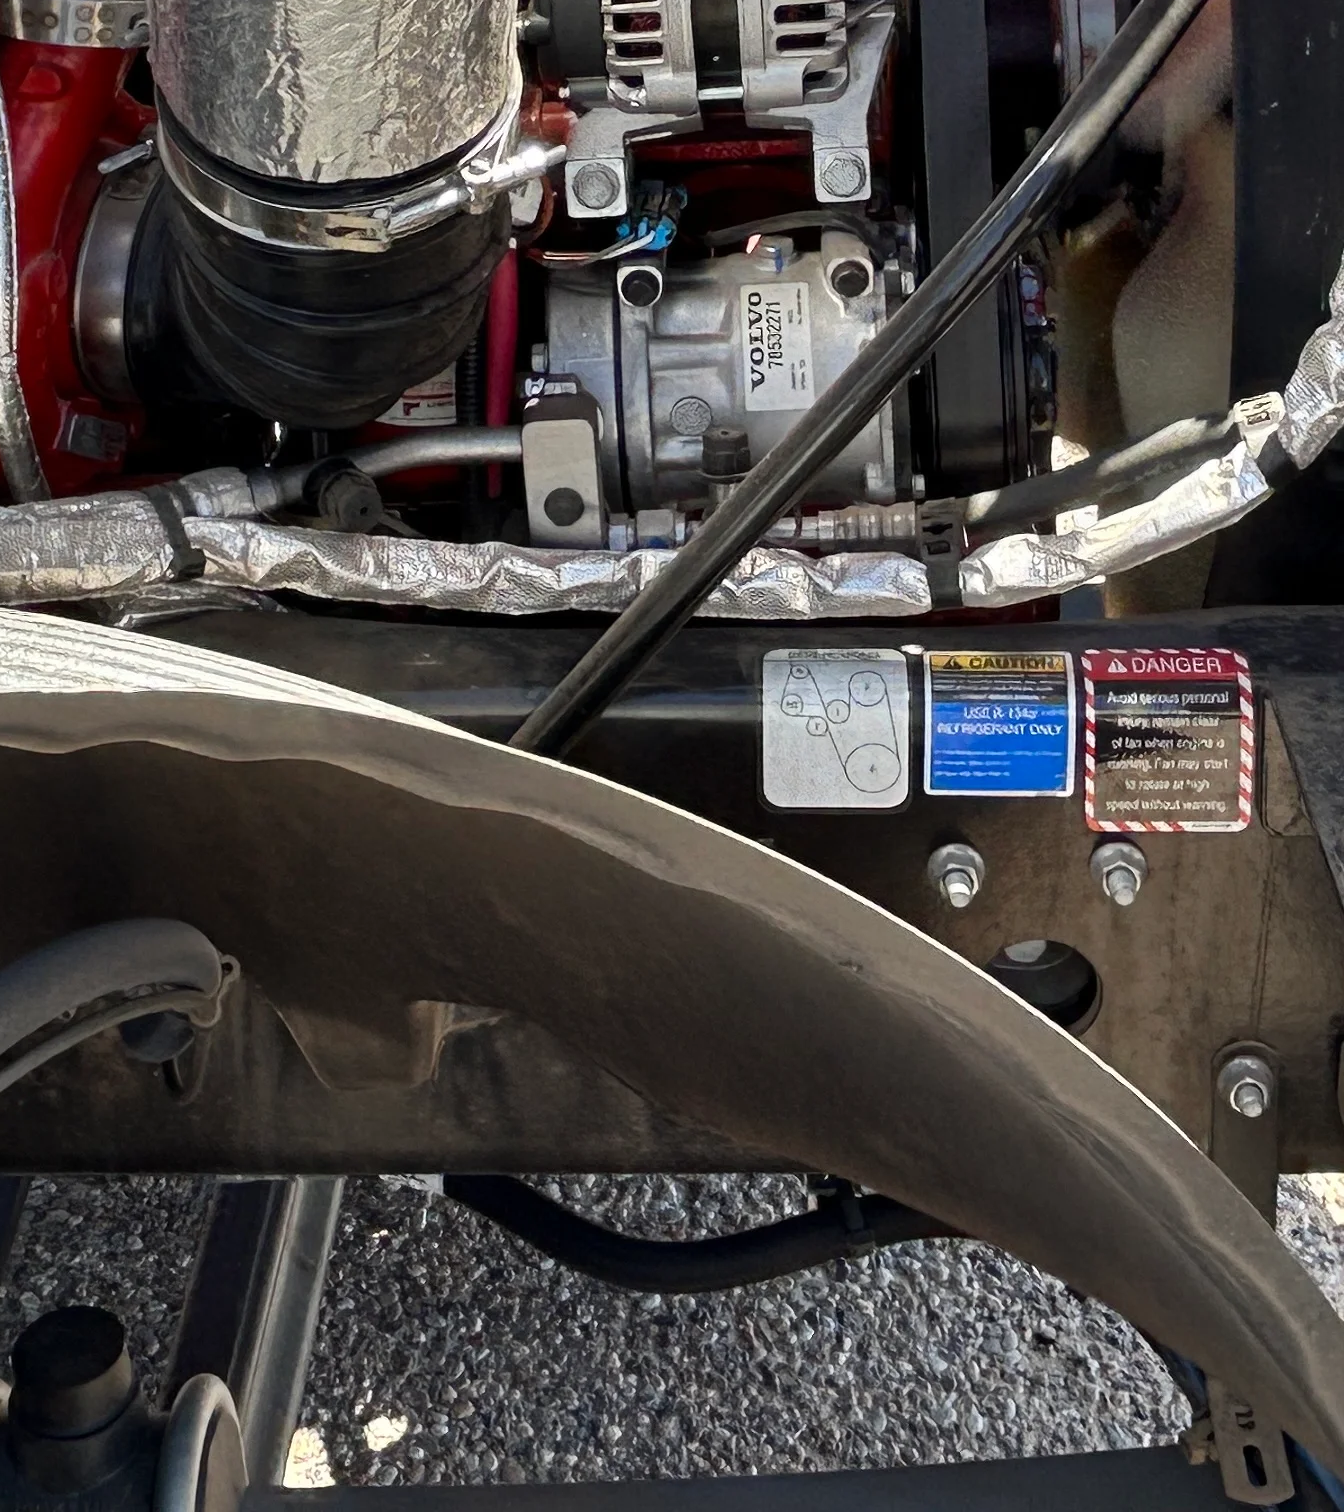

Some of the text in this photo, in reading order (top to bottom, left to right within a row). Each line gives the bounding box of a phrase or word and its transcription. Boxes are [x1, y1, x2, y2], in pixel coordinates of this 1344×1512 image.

[747, 291, 764, 393] VOLVO
[968, 655, 1058, 670] CAUTION
[1131, 656, 1223, 674] DANGER
[1029, 723, 1064, 736] ONLY
